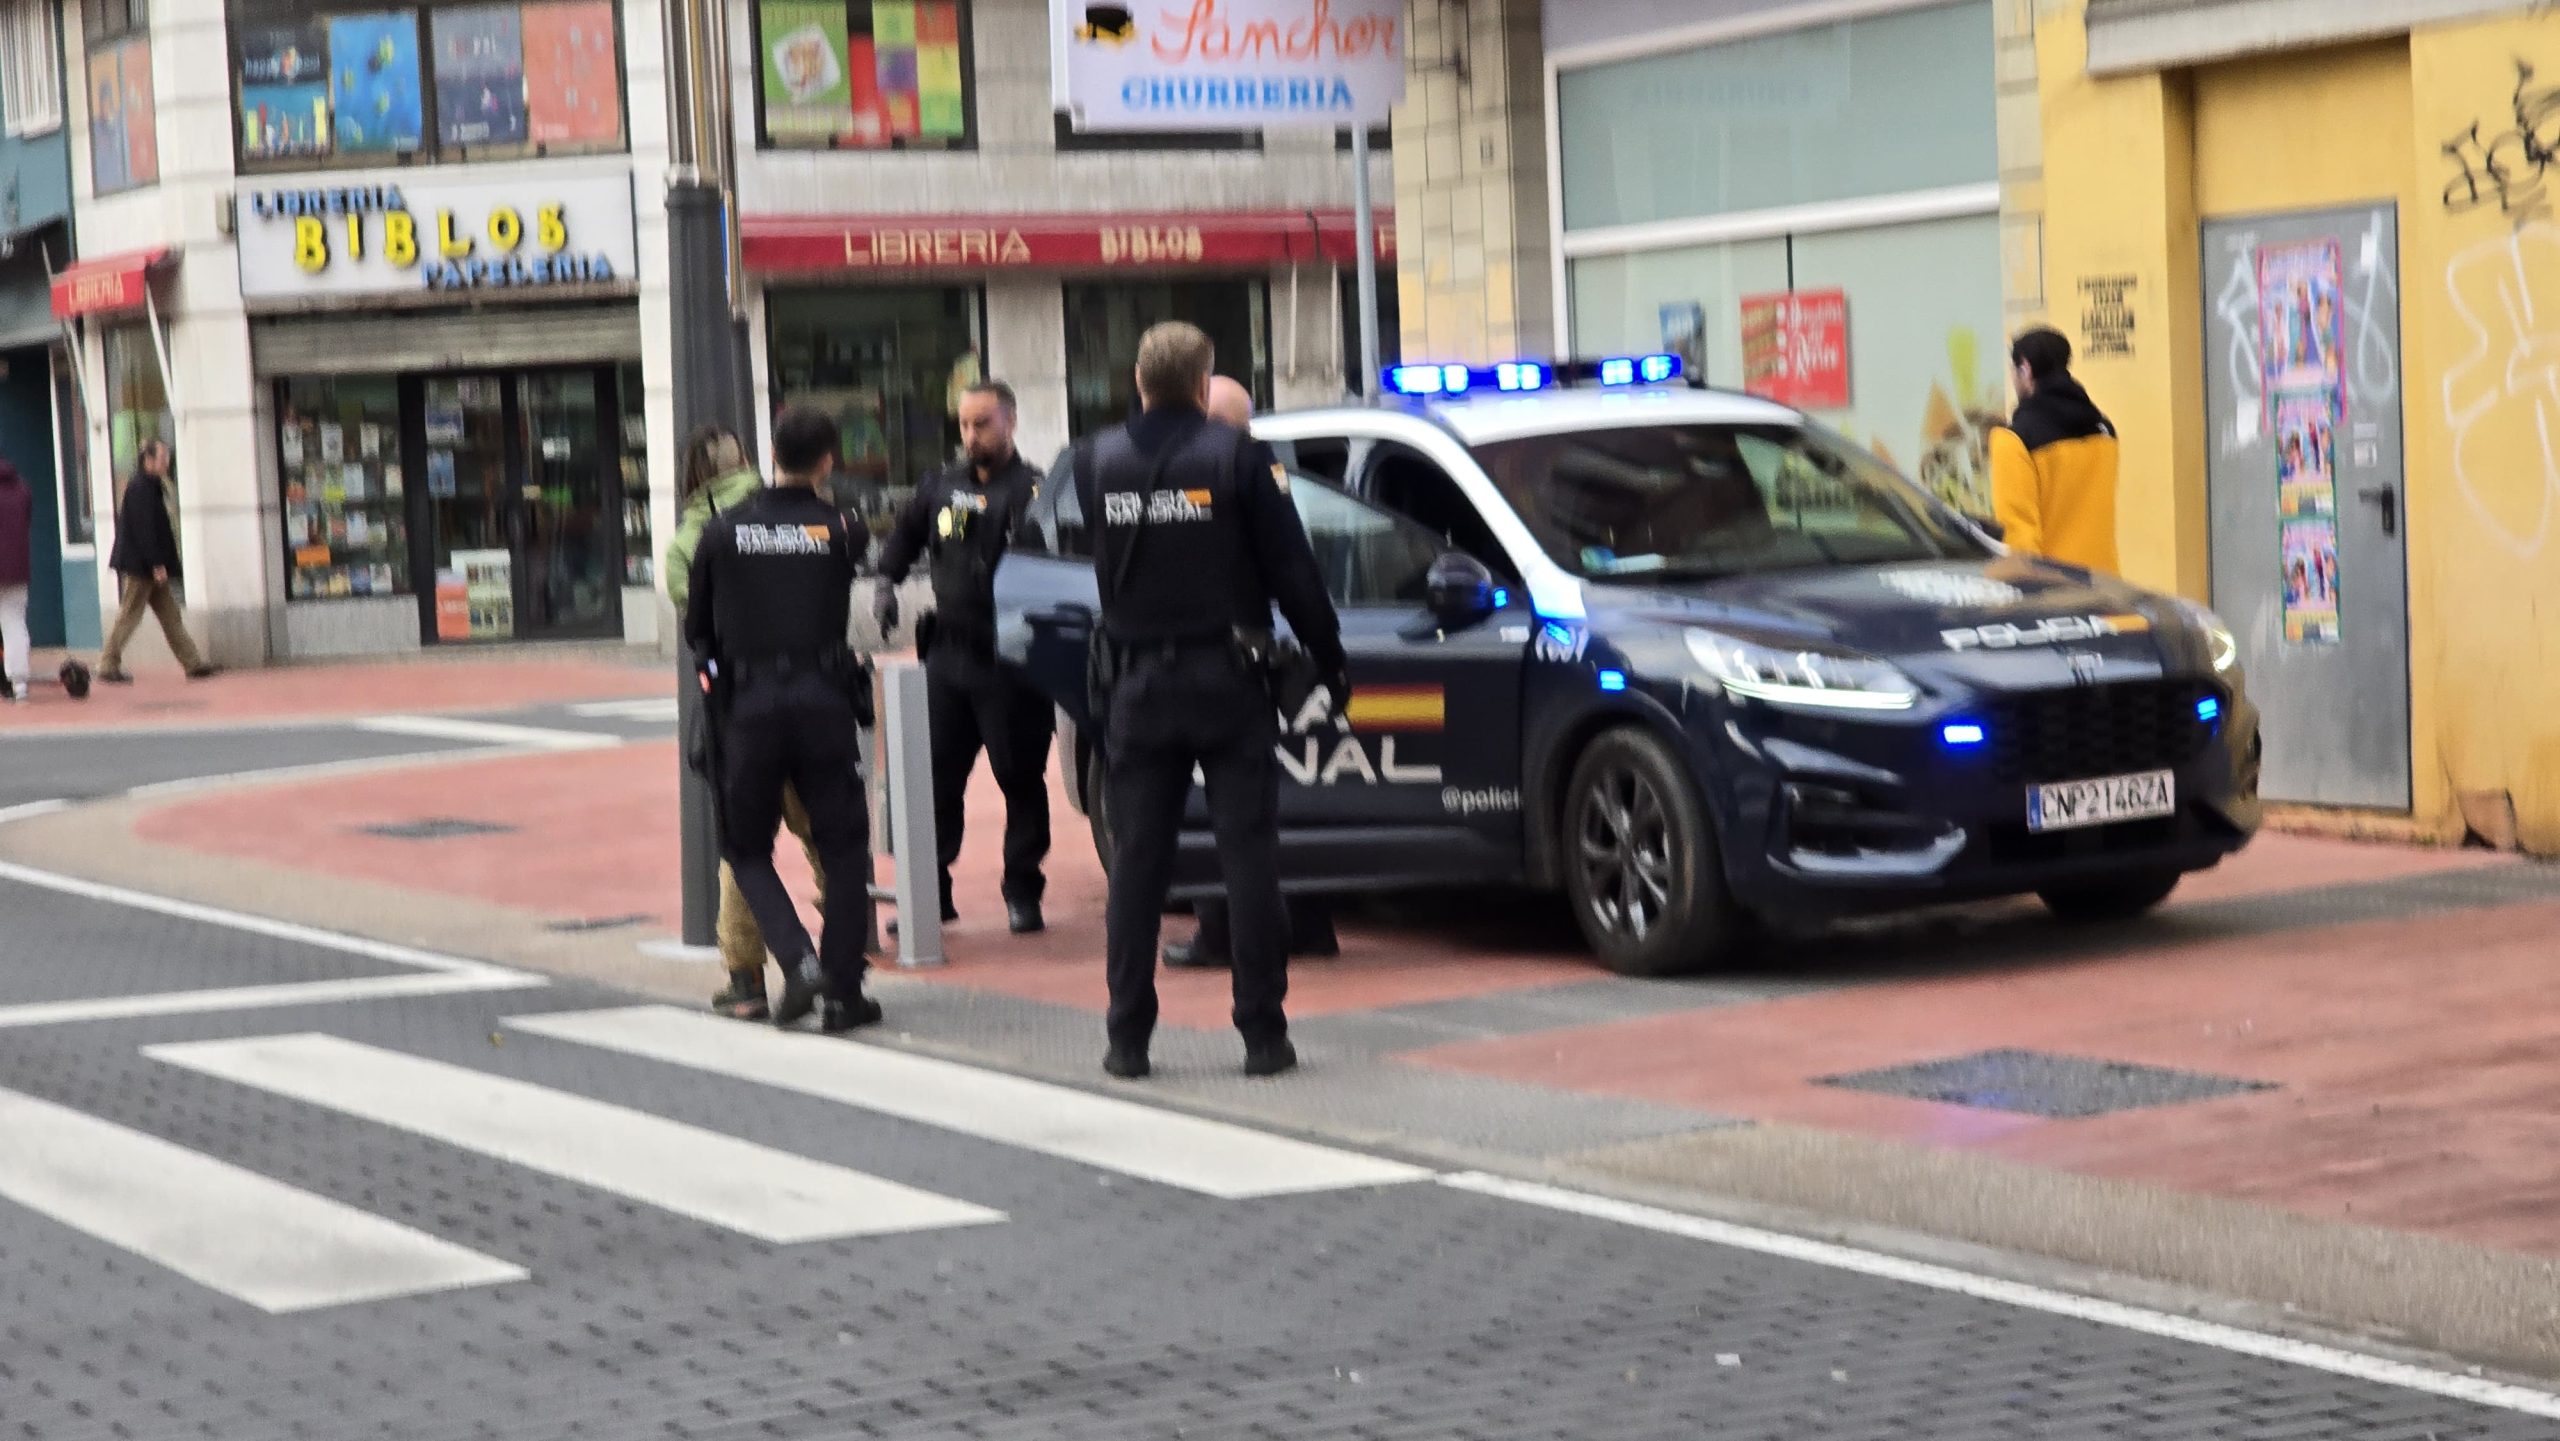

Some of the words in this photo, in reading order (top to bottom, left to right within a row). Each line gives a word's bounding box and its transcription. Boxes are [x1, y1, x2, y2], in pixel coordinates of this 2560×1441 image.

[1121, 74, 1354, 112] CHURRERIA
[252, 184, 406, 217] LIBRERIA
[295, 203, 568, 273] BIBLOS
[845, 228, 1031, 266] LIBRERIA
[1100, 226, 1203, 264] BIBLOS
[421, 253, 615, 289] PAPELERIA
[1940, 613, 2119, 653] POLICIA
